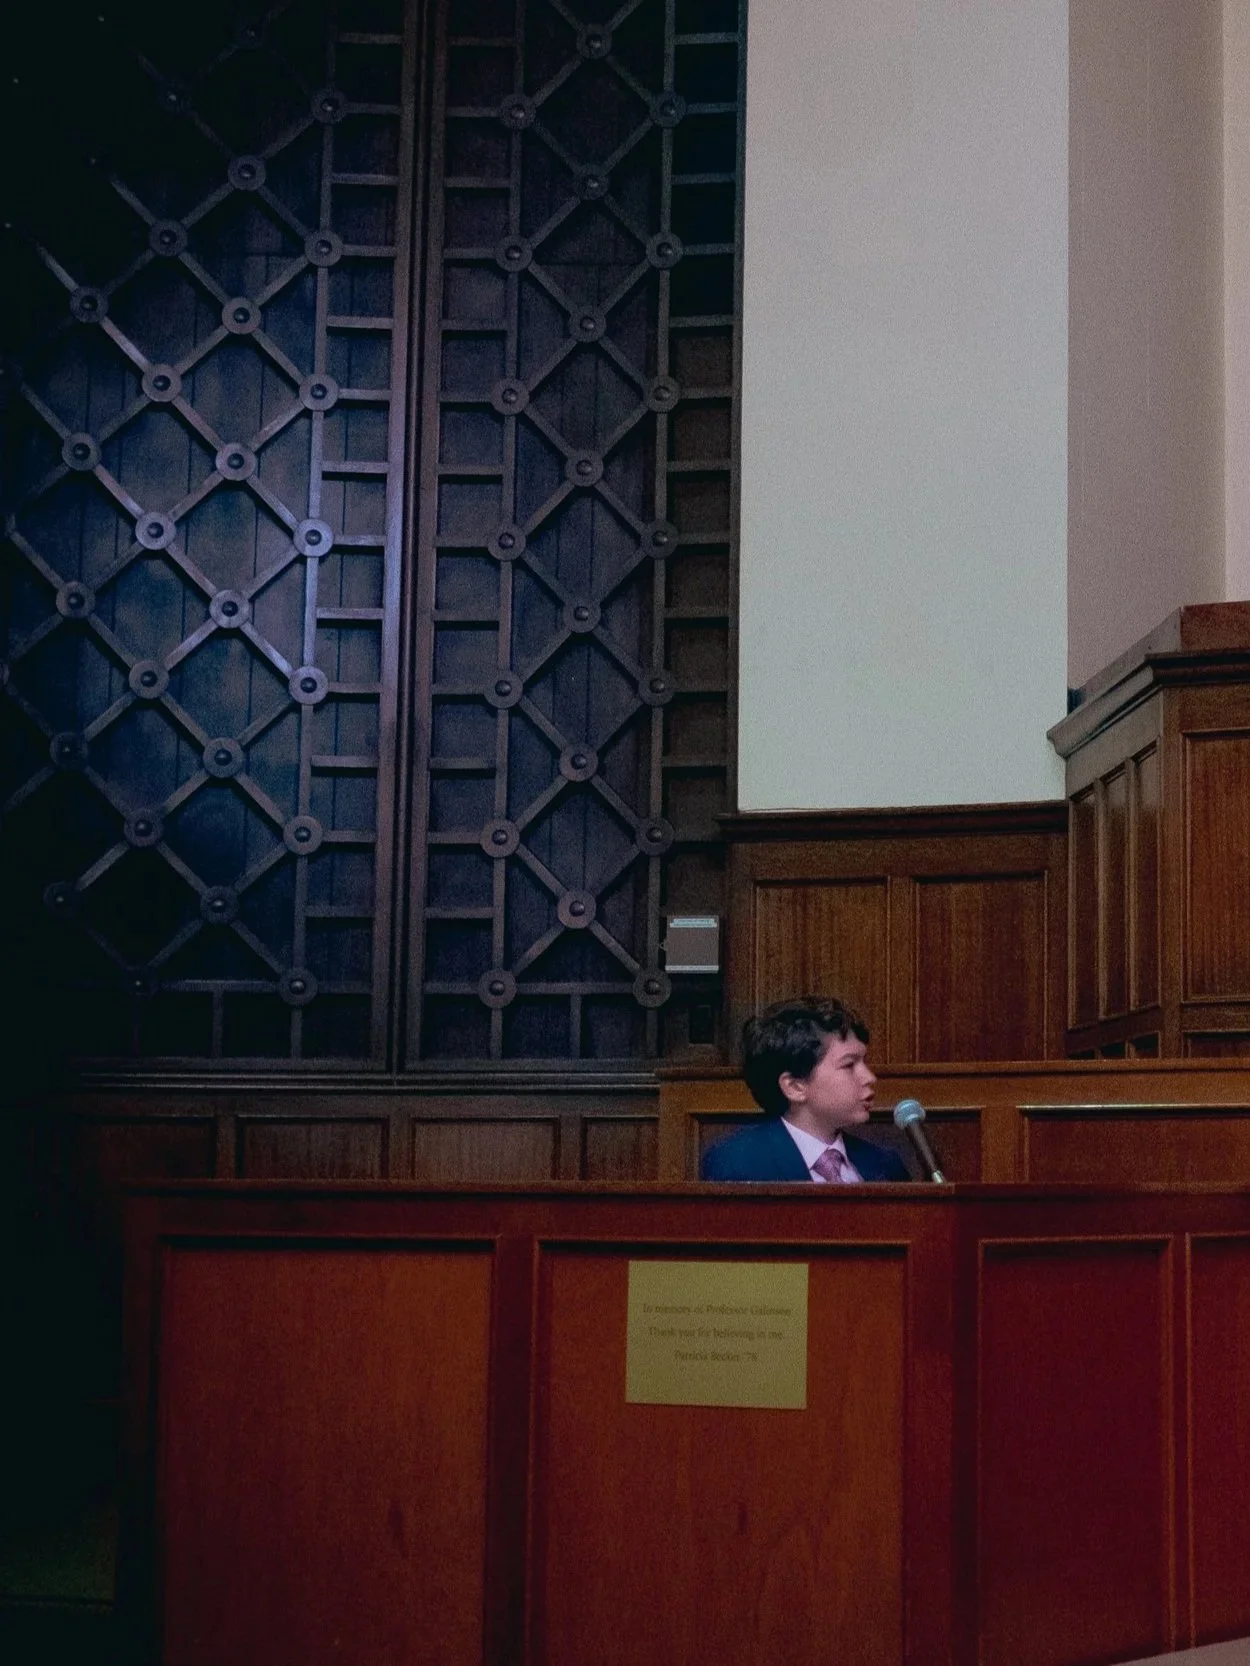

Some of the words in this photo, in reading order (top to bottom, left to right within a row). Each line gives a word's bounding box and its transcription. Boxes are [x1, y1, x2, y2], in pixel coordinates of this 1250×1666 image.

[643, 1303, 653, 1314] In
[655, 1305, 691, 1316] memory
[694, 1303, 704, 1315] of
[706, 1303, 748, 1315] Professor
[649, 1325, 674, 1337] Thank
[678, 1328, 695, 1341] you
[698, 1326, 710, 1338] for
[713, 1327, 755, 1341] believing
[757, 1328, 767, 1339] in
[674, 1350, 708, 1362] Patricia
